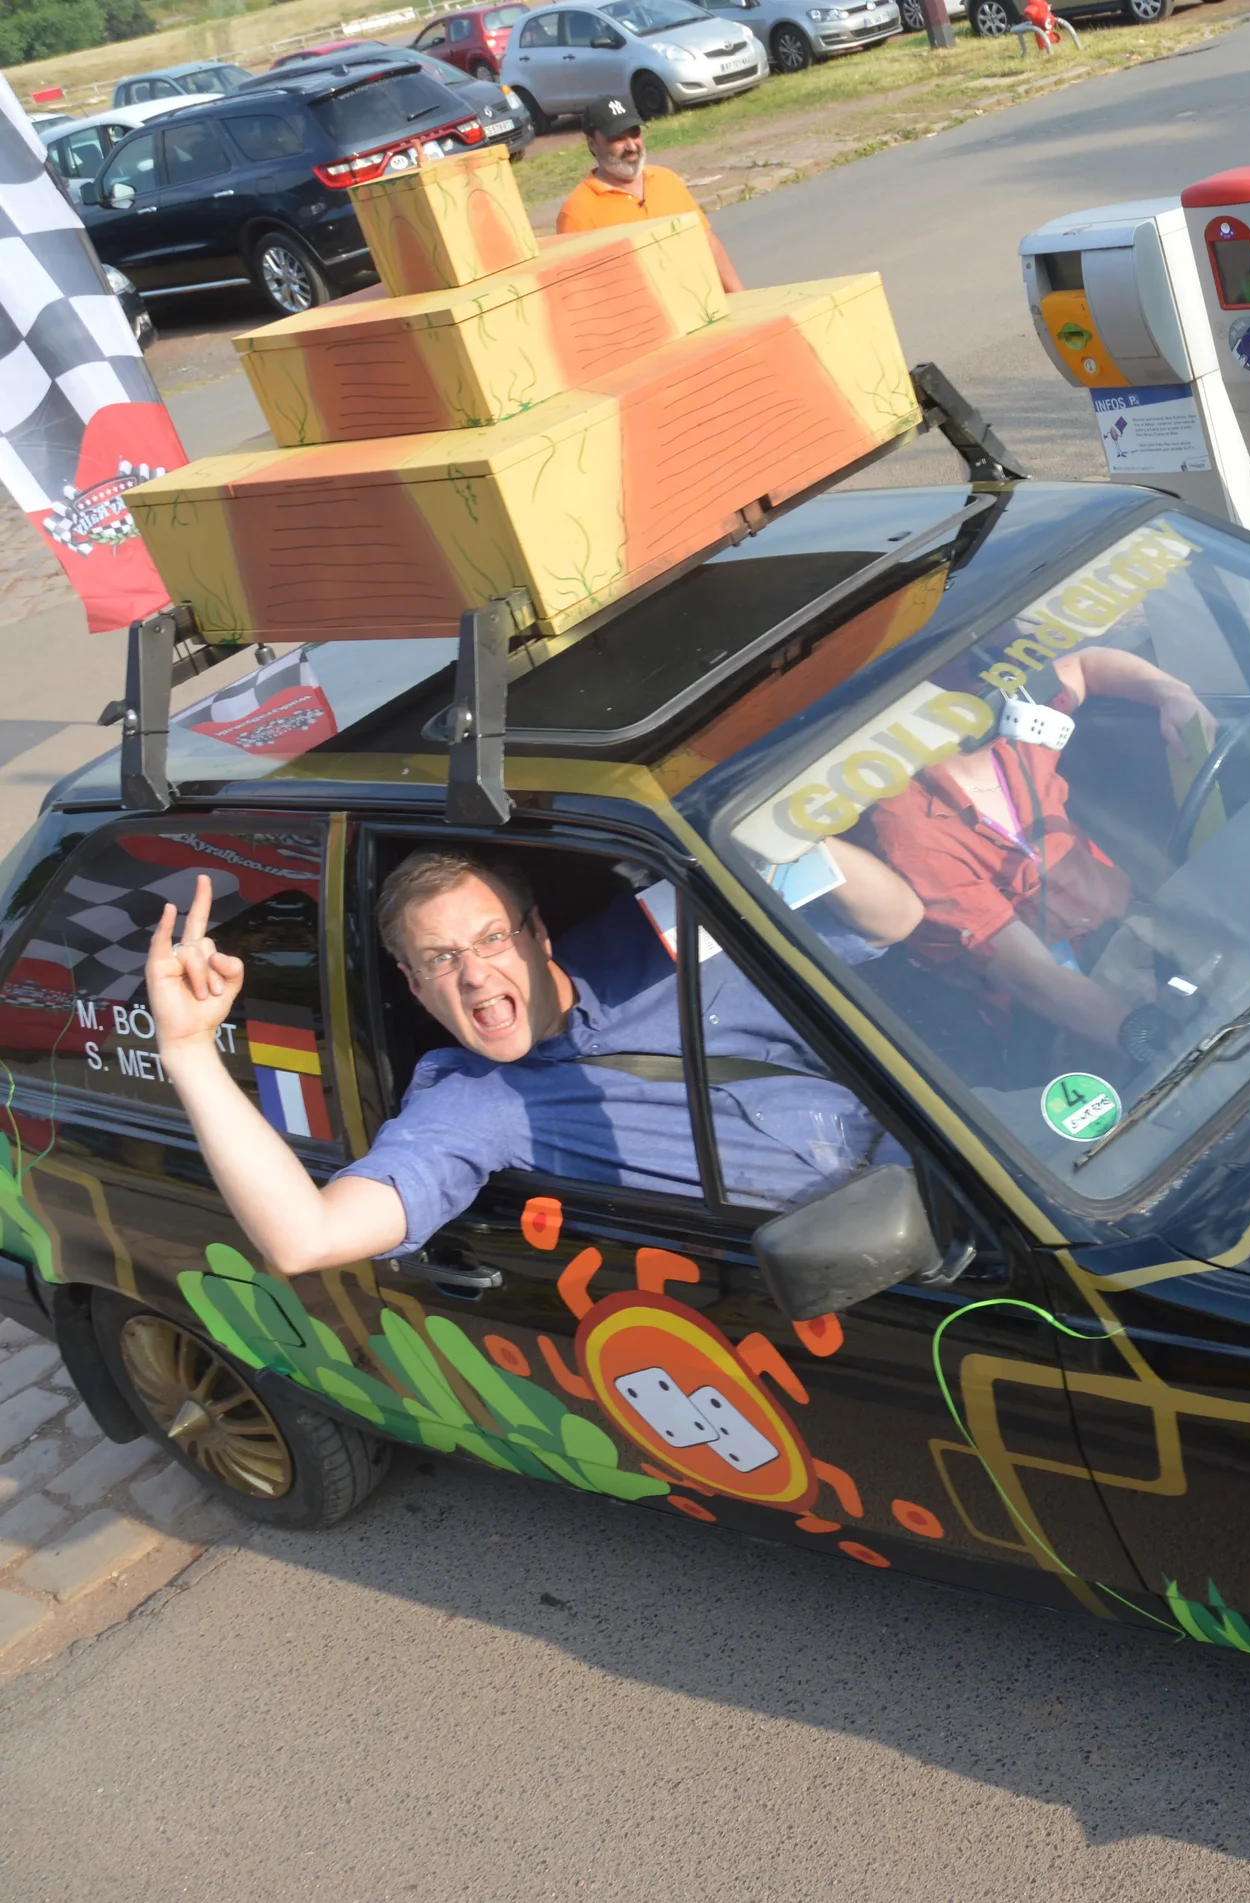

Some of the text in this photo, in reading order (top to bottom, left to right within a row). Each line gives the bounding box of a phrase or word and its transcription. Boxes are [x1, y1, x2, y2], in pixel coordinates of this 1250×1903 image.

[1094, 396, 1127, 413] INFOS
[789, 691, 995, 835] GOLD
[77, 999, 104, 1031] M.
[85, 1041, 174, 1084] S. MET
[1061, 1081, 1087, 1107] 4
